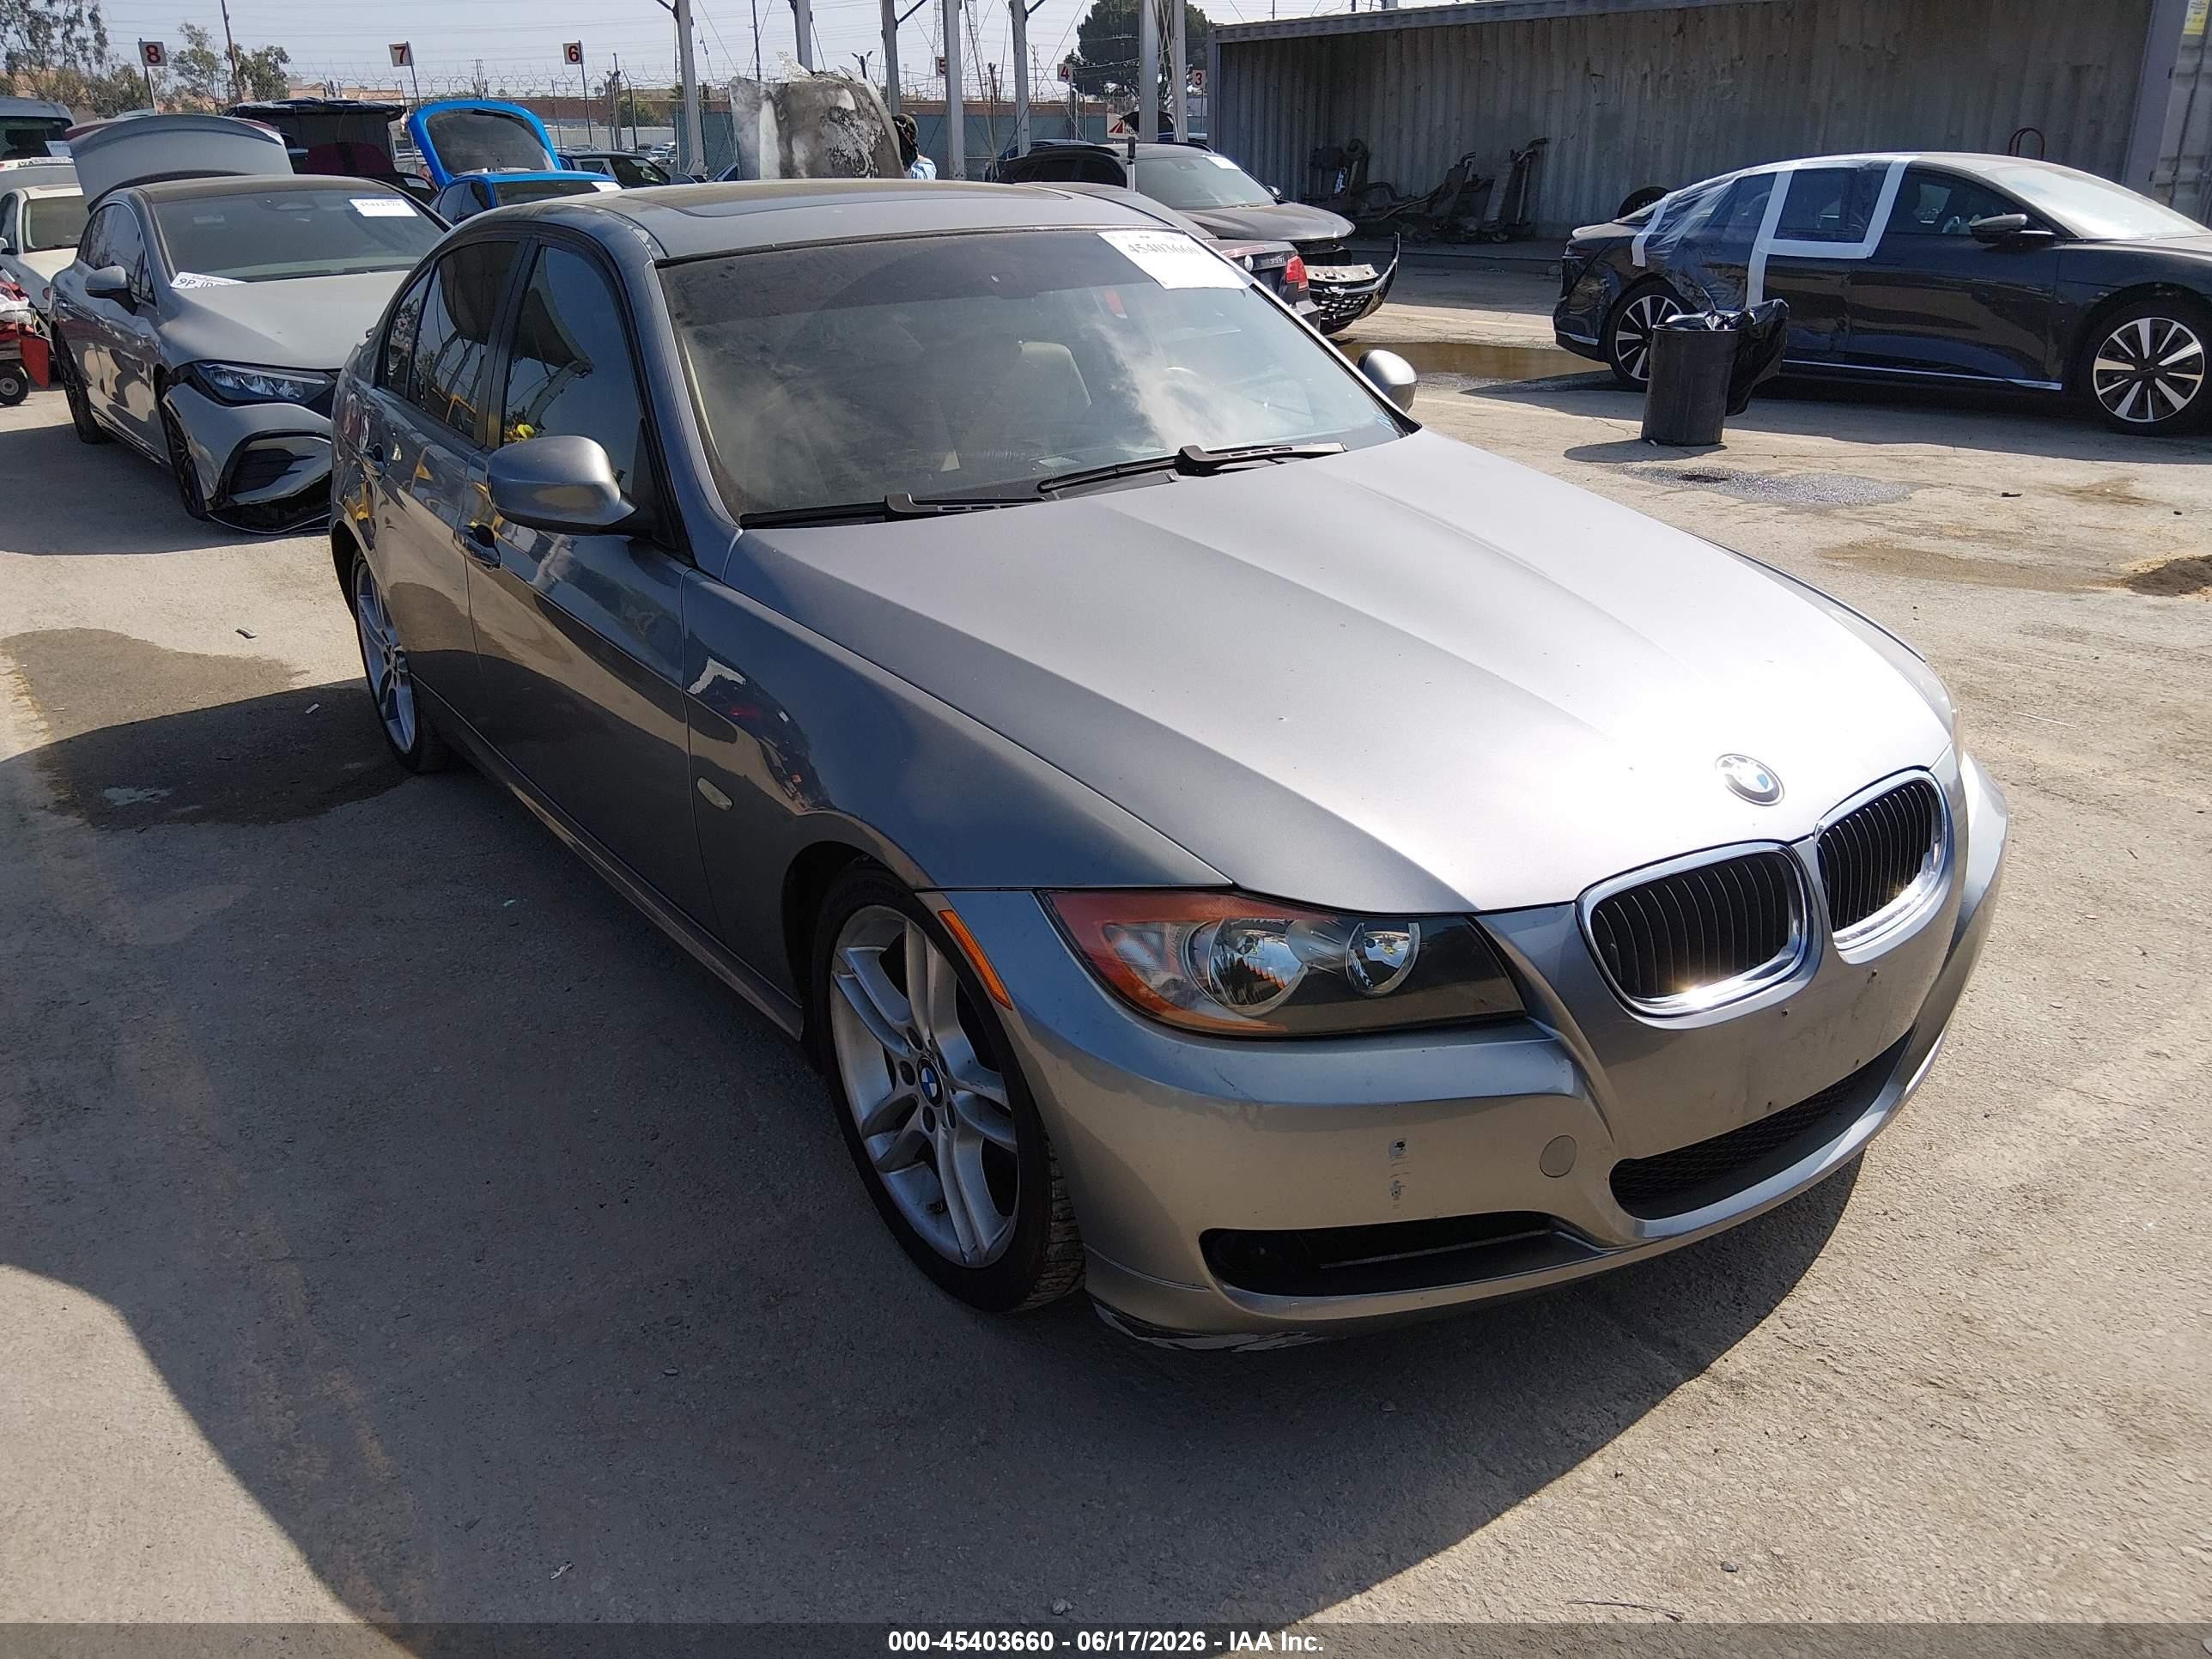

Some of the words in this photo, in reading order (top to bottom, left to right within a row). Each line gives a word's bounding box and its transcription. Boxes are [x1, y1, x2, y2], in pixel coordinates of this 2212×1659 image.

[146, 45, 161, 64] 8
[393, 46, 406, 64] 7
[568, 45, 580, 62] 6
[1060, 65, 1070, 80] 4
[1194, 72, 1202, 86] 3
